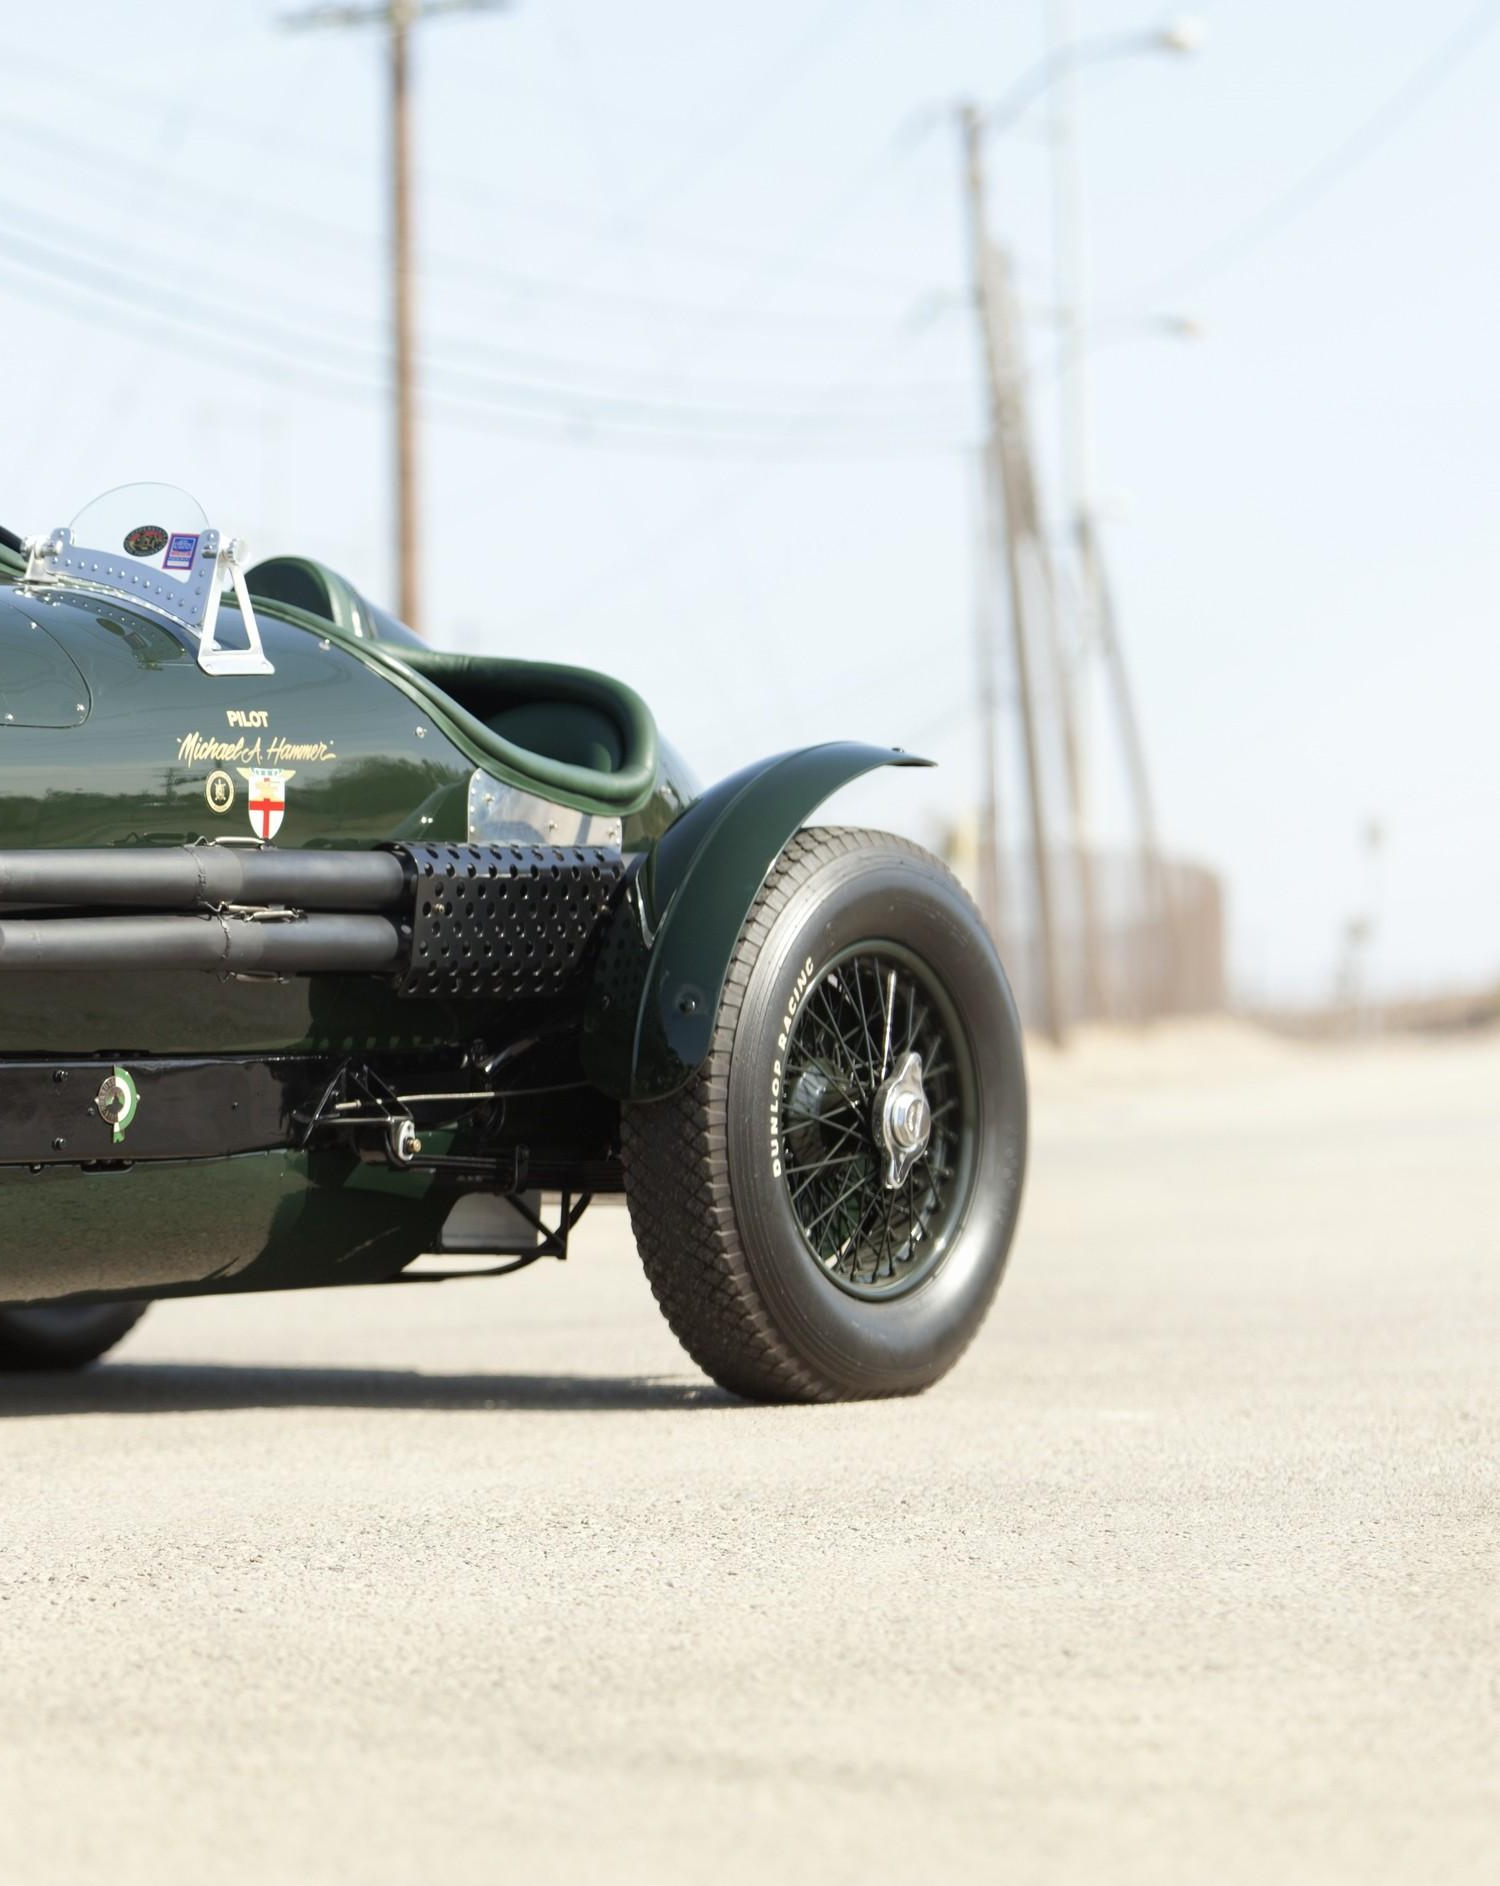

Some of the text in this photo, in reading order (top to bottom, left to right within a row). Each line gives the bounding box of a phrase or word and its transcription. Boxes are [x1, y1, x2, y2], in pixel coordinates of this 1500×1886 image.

[226, 710, 269, 728] PILOT
[770, 956, 814, 1178] DUNLOP RACING
